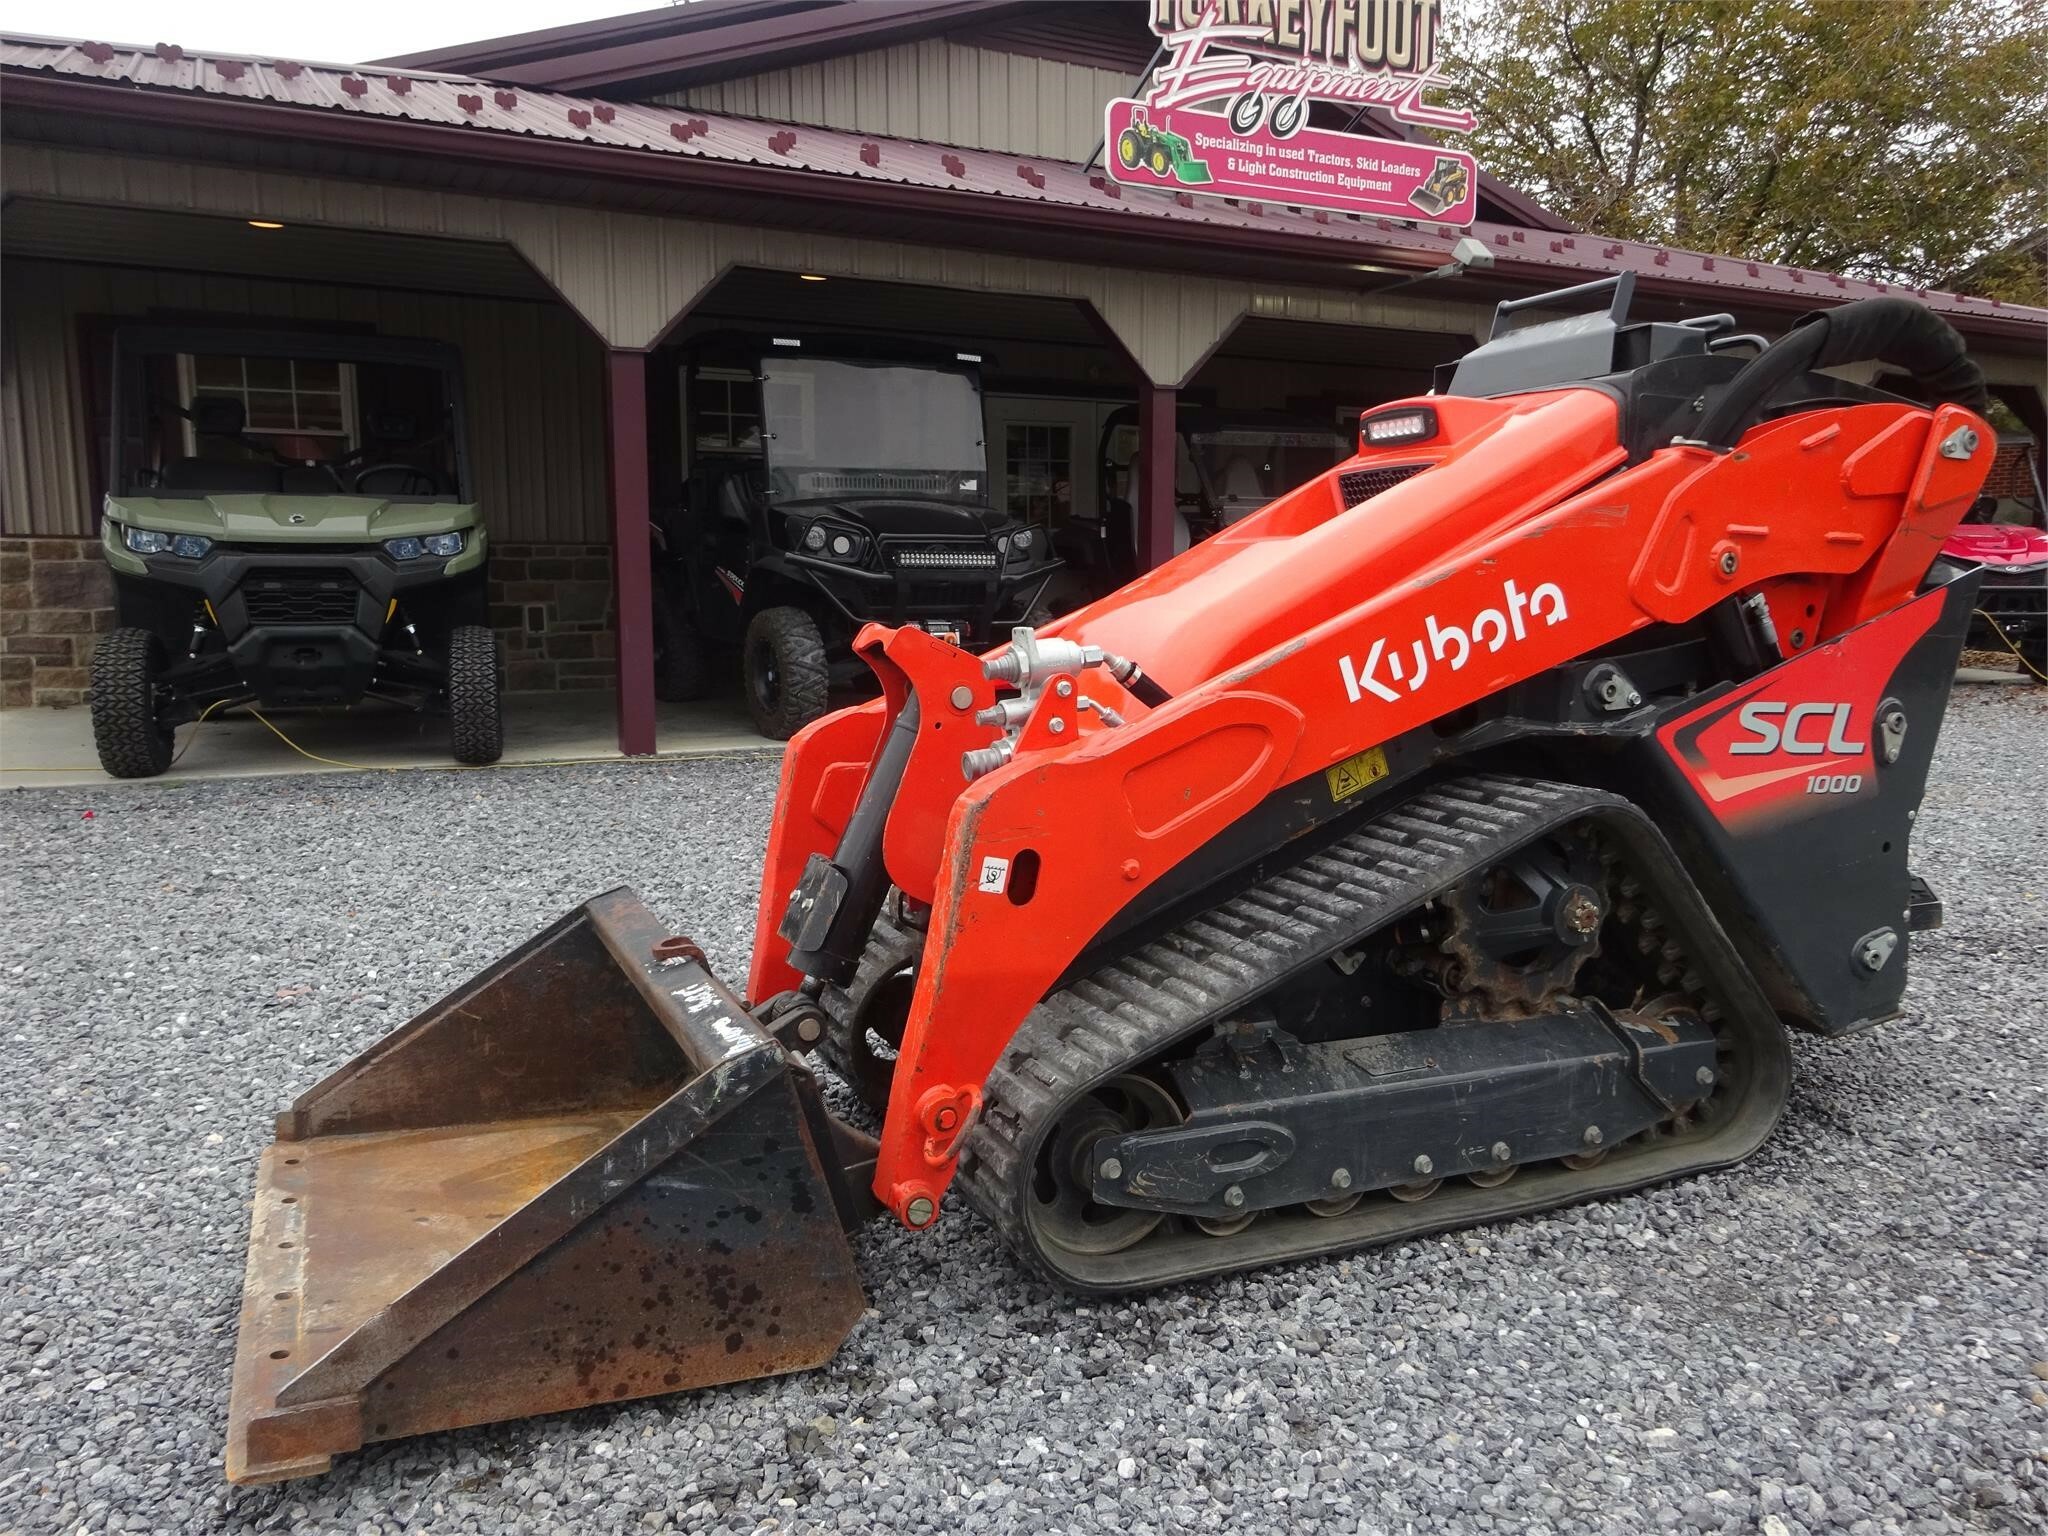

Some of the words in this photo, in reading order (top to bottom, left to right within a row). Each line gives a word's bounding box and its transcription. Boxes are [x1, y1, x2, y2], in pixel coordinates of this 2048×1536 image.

[1154, 2, 1471, 127] Equipment
[1195, 132, 1263, 157] Specializing
[1265, 143, 1276, 156] in
[1279, 148, 1304, 160] used
[1307, 149, 1354, 169] Tractors,
[1356, 156, 1378, 171] Skid
[1381, 160, 1421, 177] Loaders
[1227, 157, 1235, 170] &
[1238, 158, 1266, 176] Light
[1269, 163, 1334, 184] Construction
[1337, 172, 1392, 191] Equipment
[1338, 579, 1568, 703] Kubota
[1729, 702, 1865, 755] SCL
[1806, 775, 1862, 794] 1000
